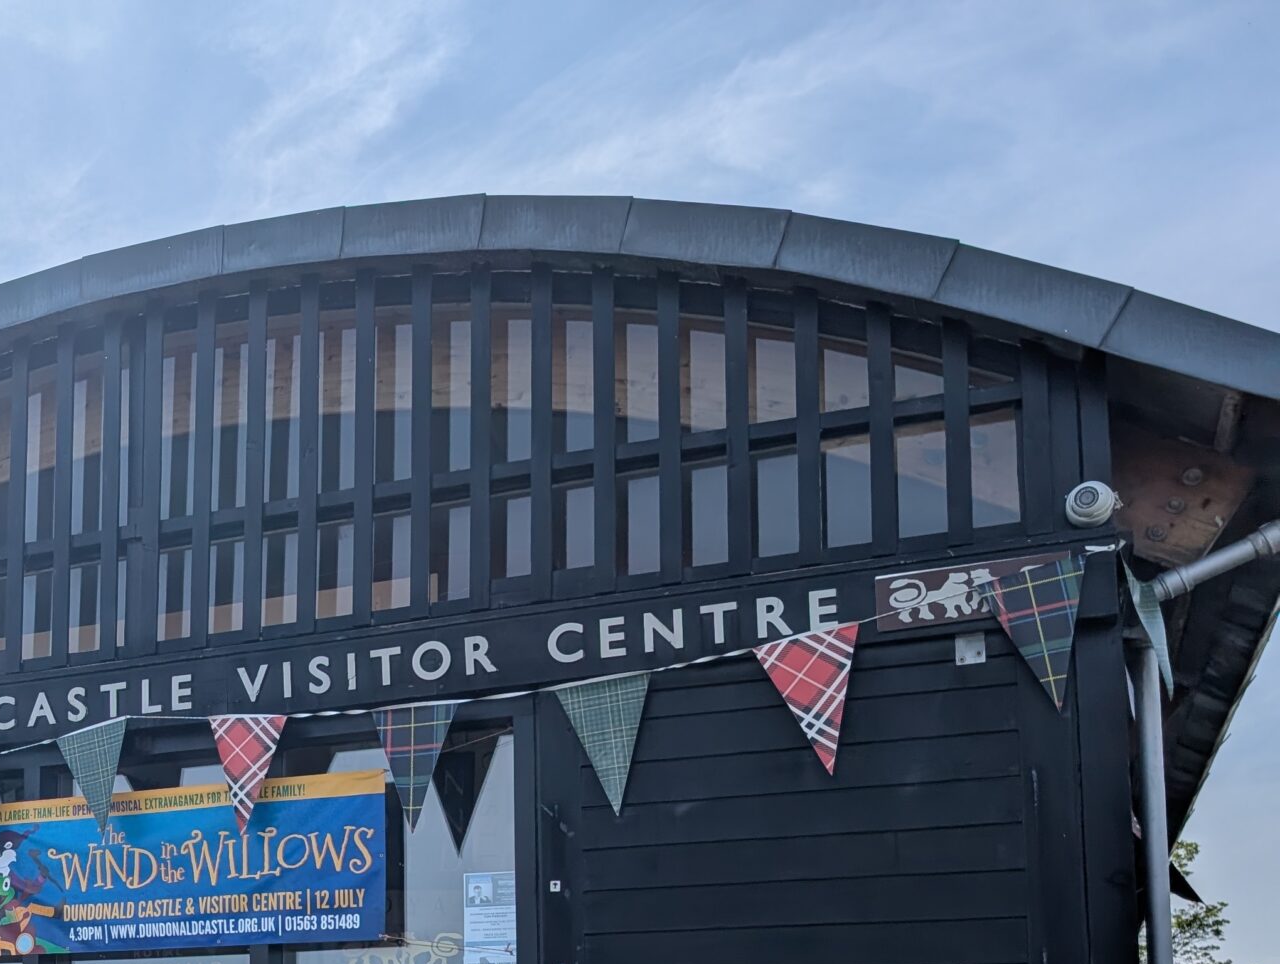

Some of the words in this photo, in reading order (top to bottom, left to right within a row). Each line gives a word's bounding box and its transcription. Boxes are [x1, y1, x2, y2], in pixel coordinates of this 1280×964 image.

[236, 635, 498, 703] VISITOR
[547, 588, 839, 664] CENTRE
[4, 805, 70, 821] LARGER-THAN-LIFE
[109, 799, 142, 814] MUSICAL
[144, 792, 205, 810] EXTRAVAGANZA
[207, 791, 221, 804] FOR
[271, 783, 305, 799] FAMILY!
[47, 843, 158, 892] WIND
[160, 841, 178, 860] in
[180, 825, 374, 887] WILLOWS
[160, 860, 186, 884] the
[63, 900, 134, 922] DUNDONALD
[138, 898, 183, 918] CASTLE
[185, 899, 195, 915] &
[198, 894, 249, 914] VISITOR
[252, 890, 302, 912] CENTRE
[314, 890, 329, 909] 12
[333, 888, 365, 909] JULY
[69, 926, 103, 941] 4.30PM
[110, 917, 276, 939] WWW.DUNDONALDCASTLE.ORG.UK
[285, 915, 317, 932] 01563
[320, 913, 360, 930] 851489
